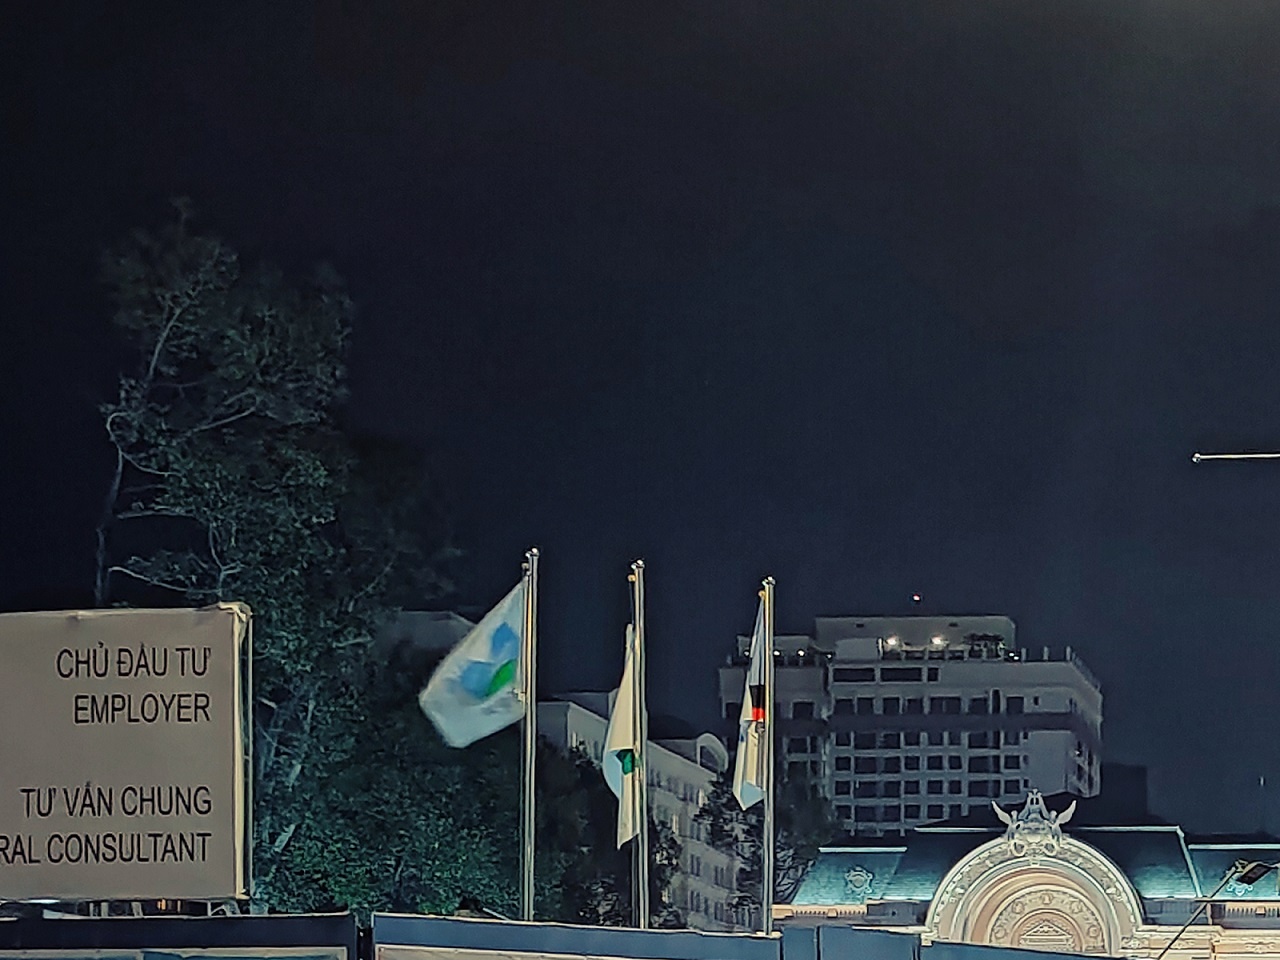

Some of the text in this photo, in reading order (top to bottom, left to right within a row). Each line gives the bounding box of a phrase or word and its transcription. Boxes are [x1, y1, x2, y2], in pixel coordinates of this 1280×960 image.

[56, 641, 109, 678] CHỦ
[175, 647, 211, 677] TƯ
[74, 693, 210, 724] EMPLOYER
[20, 788, 56, 818] TƯ
[121, 786, 212, 816] CHUNG
[47, 832, 212, 864] CONSULTANT
